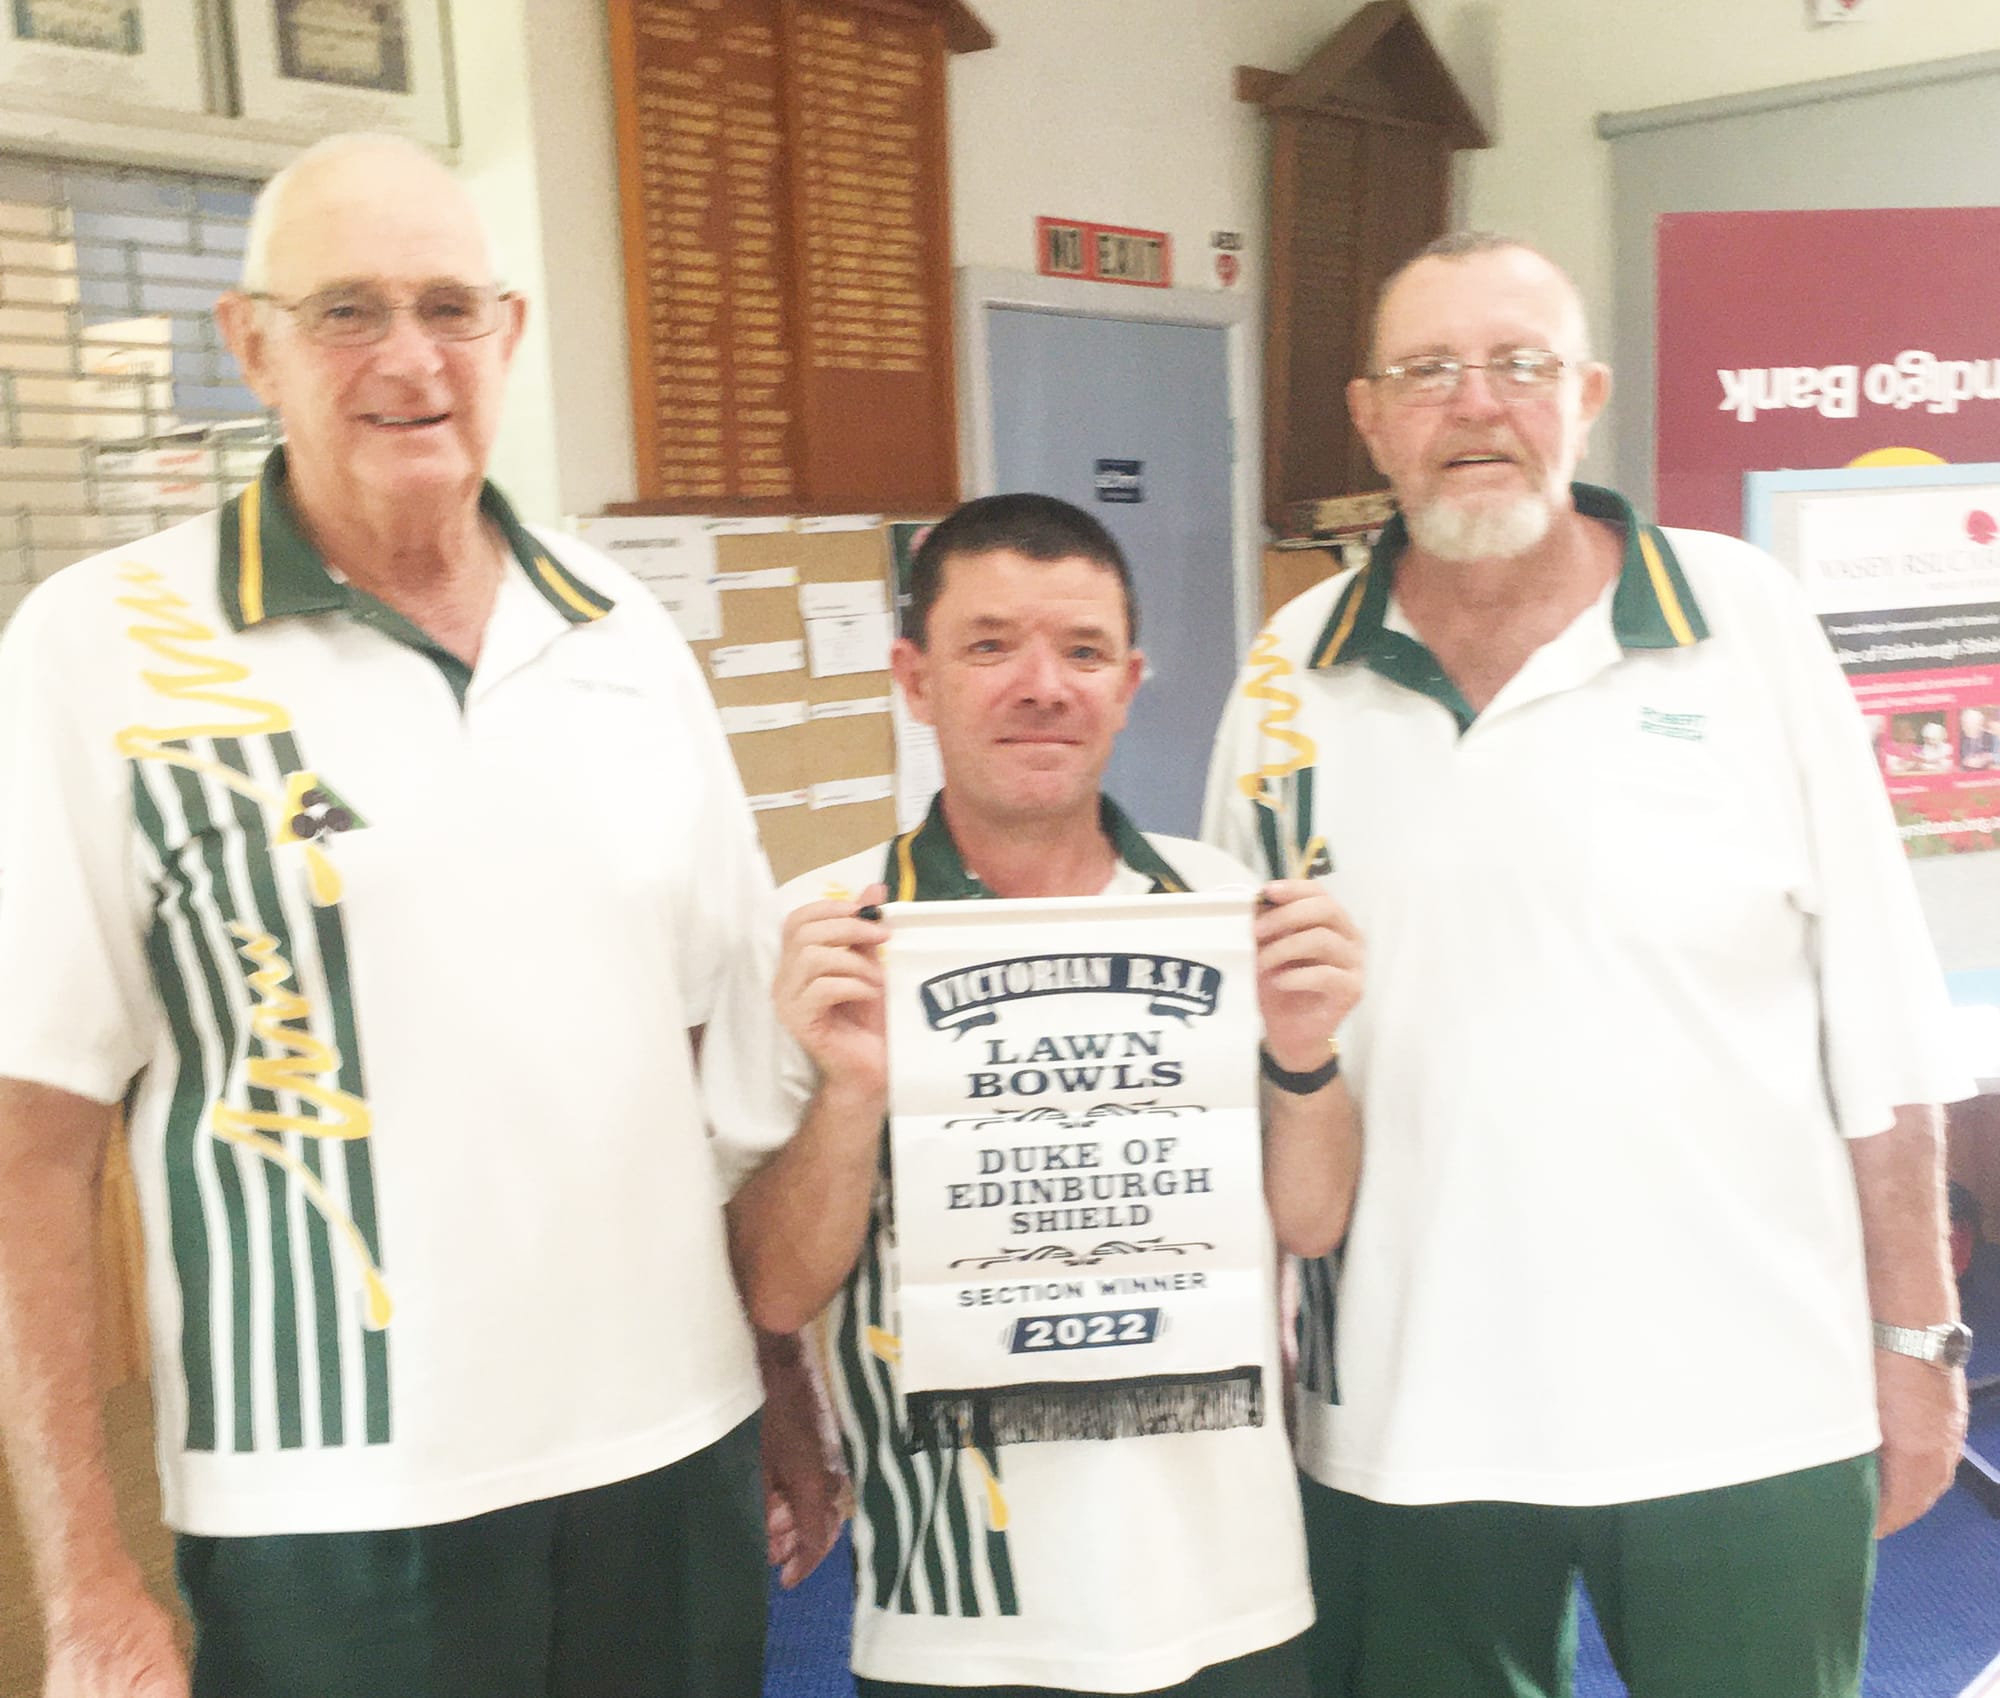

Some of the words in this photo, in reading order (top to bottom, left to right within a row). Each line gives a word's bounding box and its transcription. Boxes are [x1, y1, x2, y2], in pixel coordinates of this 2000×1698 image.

[1717, 365, 1859, 423] Bank
[927, 957, 1112, 1012] VICTORIAN
[985, 1031, 1163, 1066] LAWN
[966, 1061, 1183, 1099] BOWLS
[978, 1143, 1100, 1176] DUKE
[1123, 1137, 1179, 1167] OF
[946, 1167, 1214, 1211] EDINBURGH
[1010, 1204, 1152, 1236] SHIELD
[957, 1281, 1085, 1308] SECTION
[1099, 1271, 1209, 1297] WINNER
[1023, 1312, 1149, 1349] 2022
